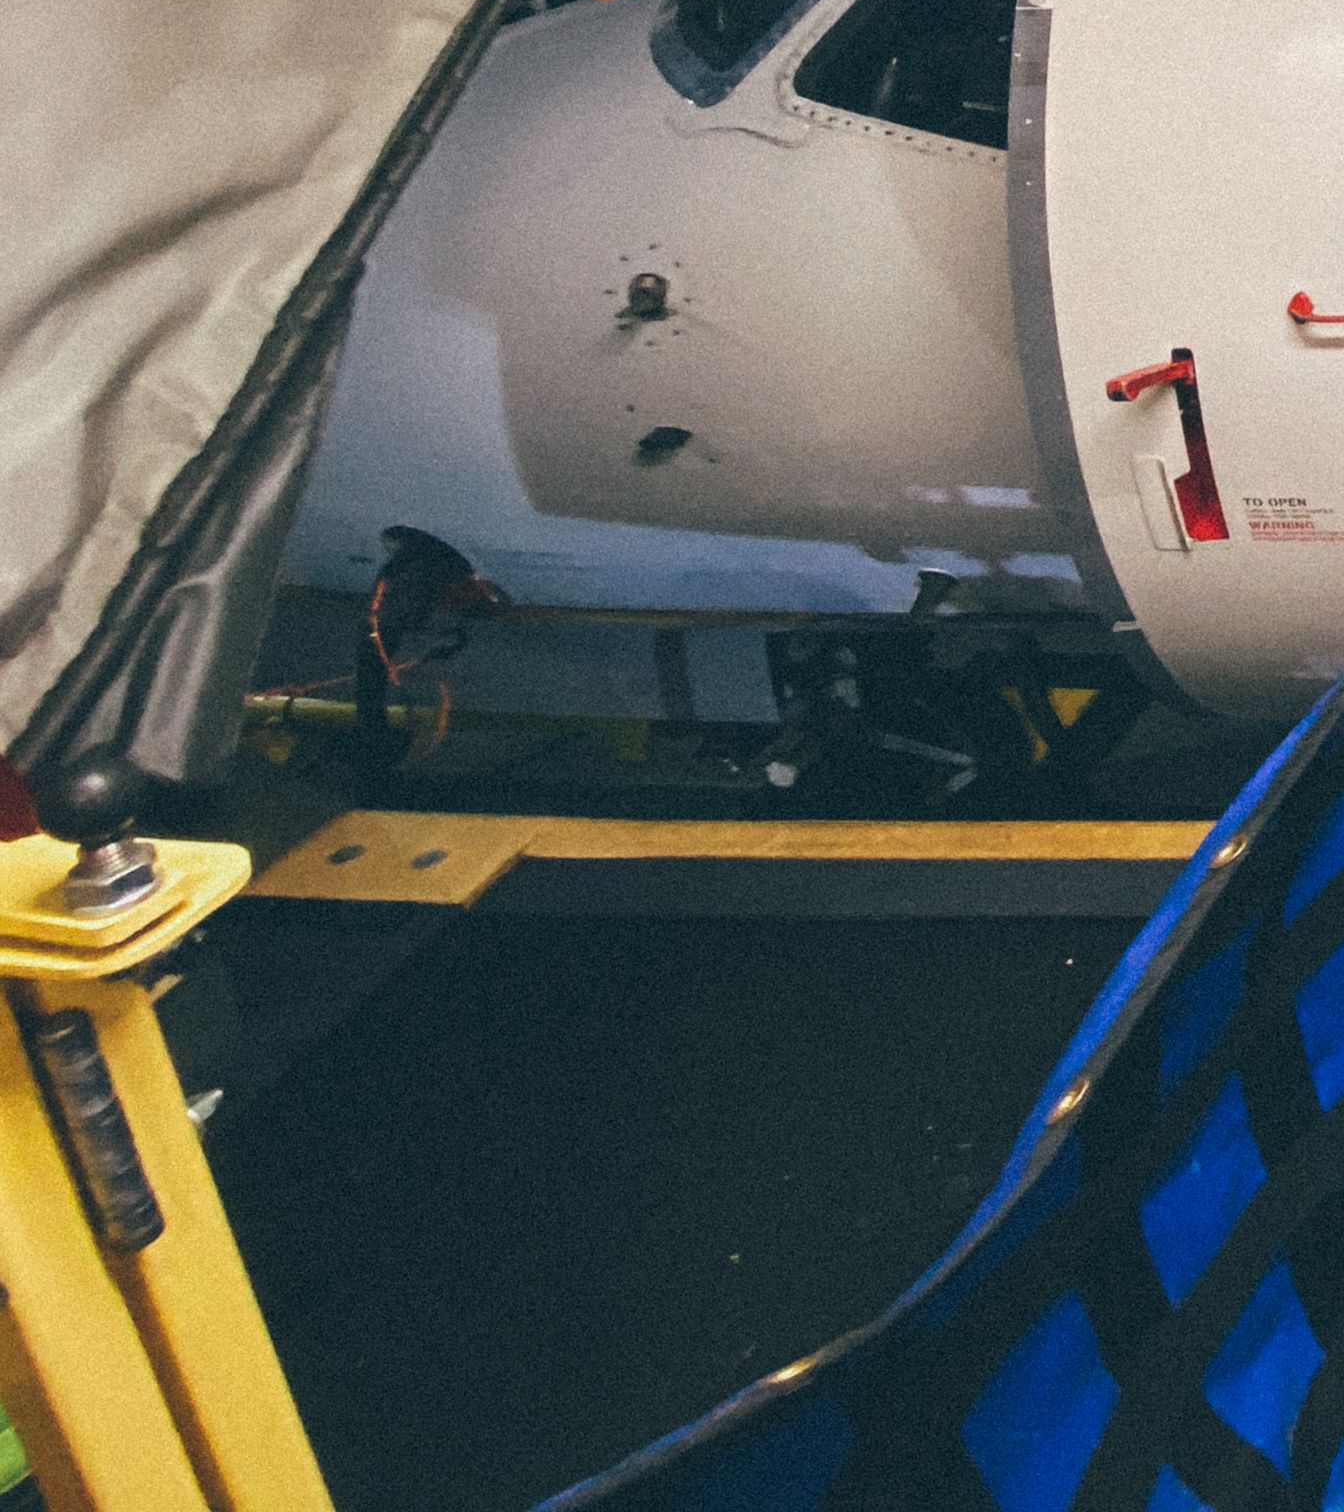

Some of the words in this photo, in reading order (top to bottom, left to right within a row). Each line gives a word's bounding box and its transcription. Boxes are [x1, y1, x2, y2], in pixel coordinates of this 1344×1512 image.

[1243, 497, 1263, 507] TO
[1268, 497, 1308, 507] OPEN
[1249, 521, 1316, 530] WARNING
